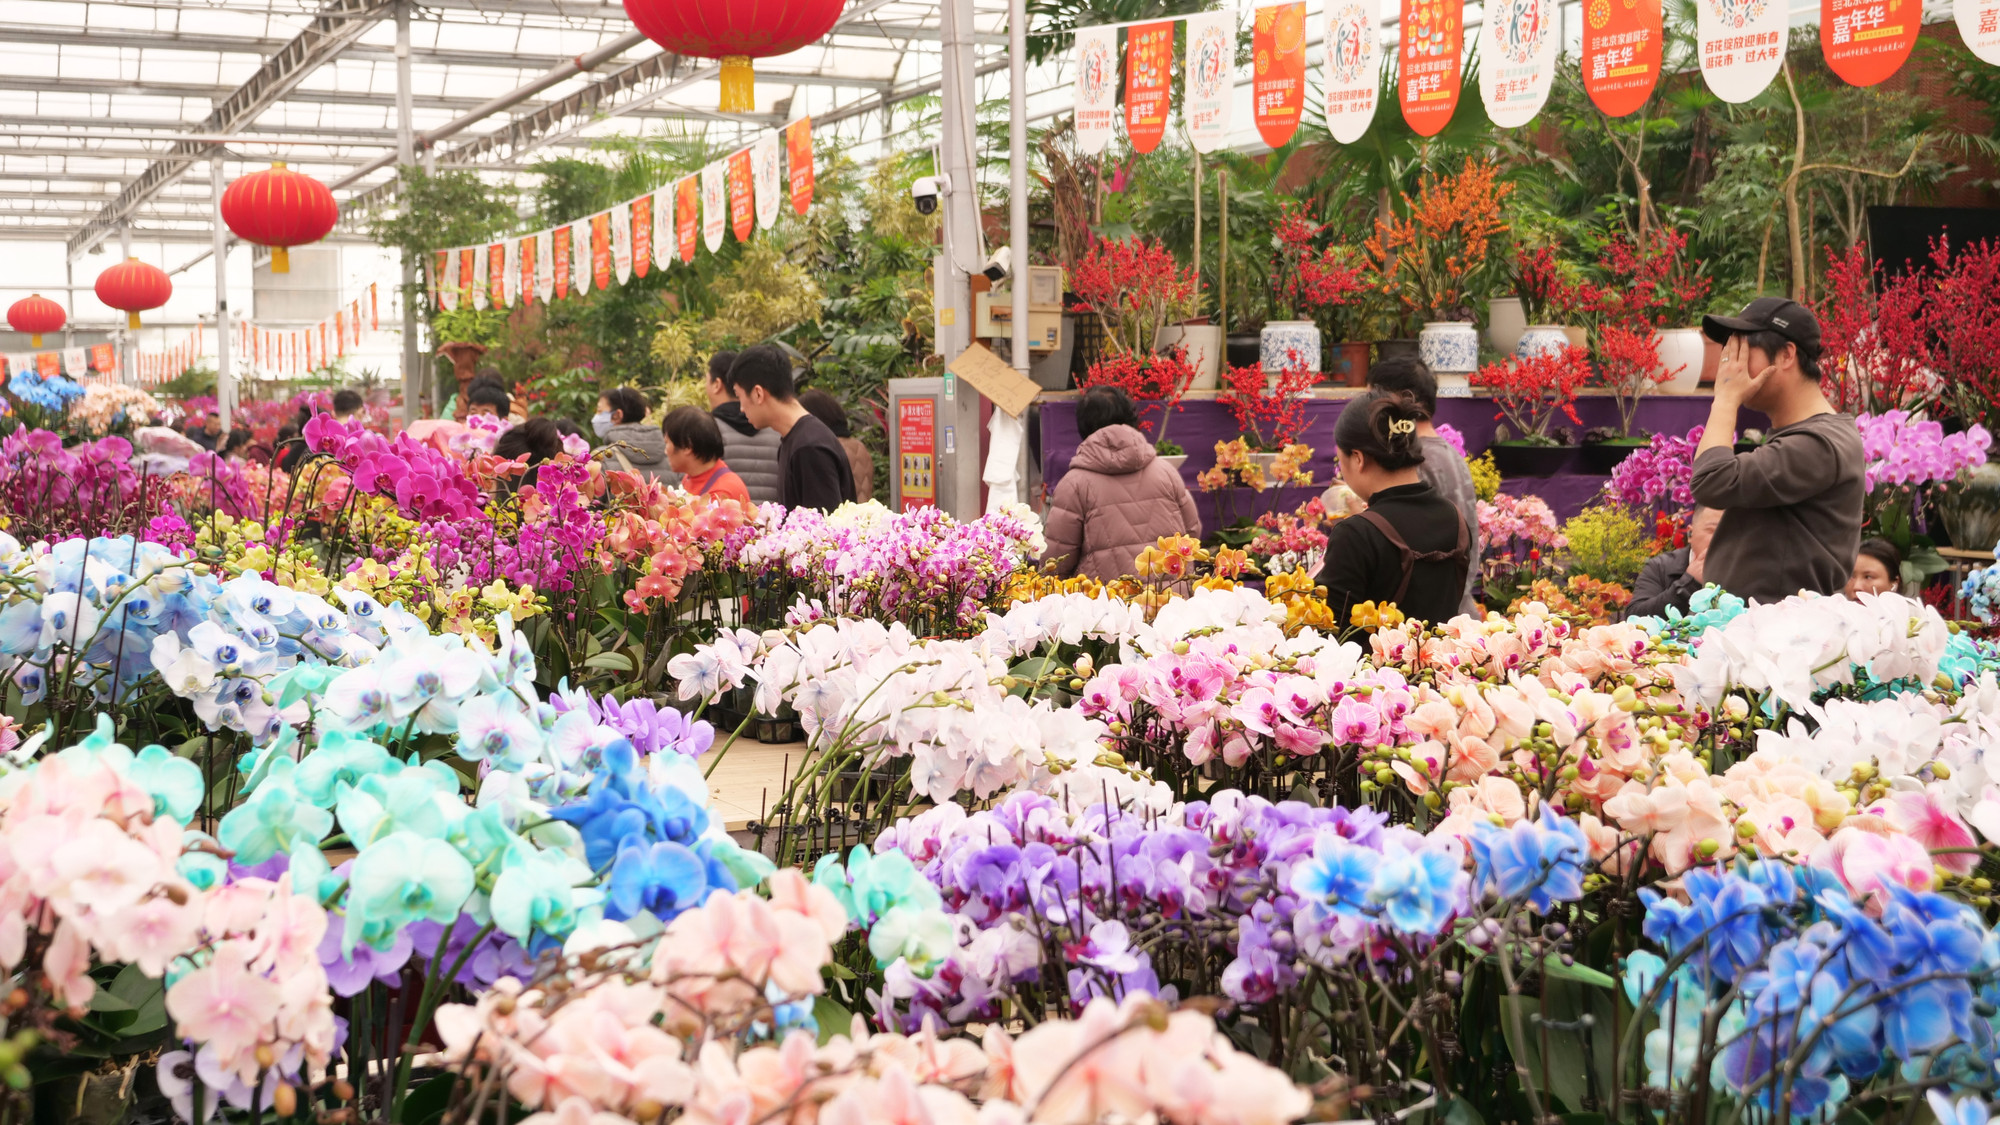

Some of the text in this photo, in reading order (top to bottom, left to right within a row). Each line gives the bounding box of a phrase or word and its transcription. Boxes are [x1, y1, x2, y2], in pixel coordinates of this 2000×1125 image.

[1833, 6, 1885, 45] 嘉年华
[1978, 8, 2000, 35] 嘉
[1705, 31, 1778, 54] 百花绽放迎新春
[1592, 46, 1633, 80] 嘉年华
[1406, 74, 1440, 102] 嘉年华
[1494, 78, 1528, 102] 嘉年华
[1258, 91, 1284, 116] 嘉年华
